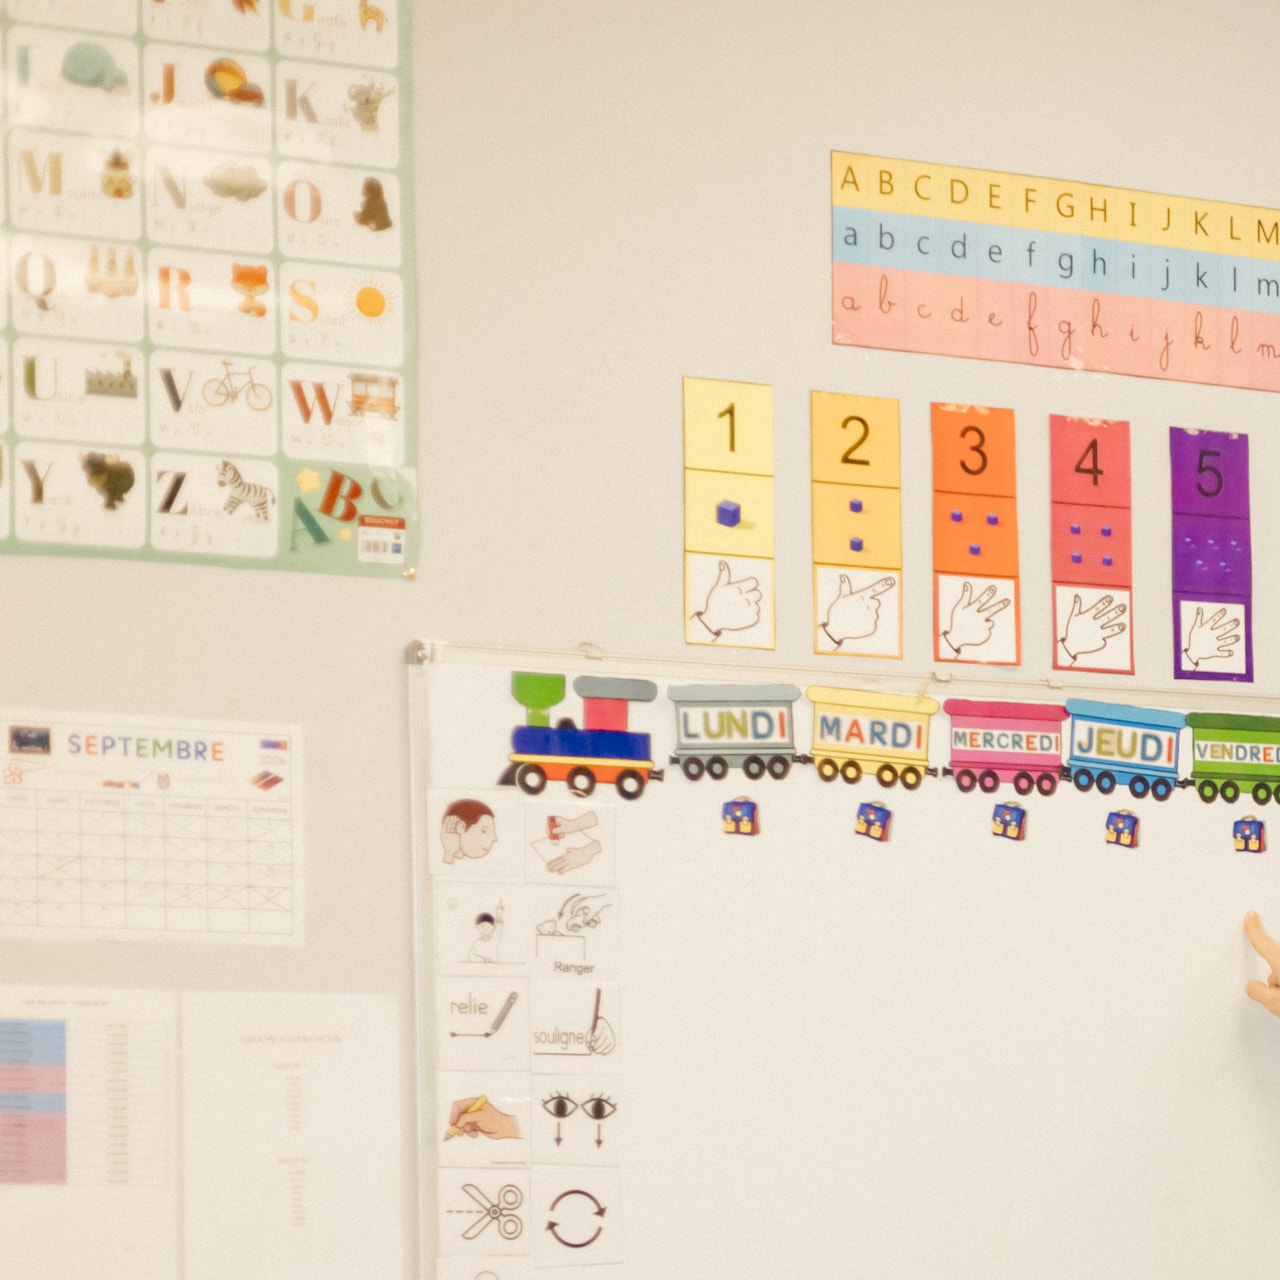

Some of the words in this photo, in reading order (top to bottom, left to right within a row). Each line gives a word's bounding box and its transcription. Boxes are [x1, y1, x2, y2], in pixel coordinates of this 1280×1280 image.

[151, 63, 175, 105] J
[285, 78, 320, 123] K
[283, 179, 322, 223] O
[841, 166, 859, 191] A
[880, 170, 893, 195] B
[914, 175, 931, 200] C
[951, 179, 968, 204] D
[989, 184, 1001, 209] E
[1025, 188, 1036, 212] F
[1057, 193, 1074, 218] G
[1090, 197, 1107, 222] H
[1130, 202, 1136, 226] I
[1162, 208, 1170, 231] J
[1195, 211, 1208, 236] K
[1230, 216, 1241, 240] L
[1258, 220, 1278, 245] M
[844, 227, 857, 246] a
[880, 223, 894, 250] b
[917, 236, 929, 254] c
[951, 233, 966, 258] d
[989, 245, 1002, 263] e
[1027, 241, 1035, 266] f
[1059, 253, 1073, 278] g
[1093, 249, 1106, 275] h
[1162, 259, 1169, 291] j
[1197, 262, 1207, 288] k
[1258, 279, 1279, 297] m
[288, 278, 319, 322] S
[158, 368, 195, 413] V
[288, 379, 344, 426] W
[718, 403, 735, 452] 1
[841, 416, 869, 465] 2
[960, 426, 987, 475] 3
[1075, 439, 1103, 486] 4
[1196, 449, 1223, 498] 5
[21, 459, 54, 504] Y
[157, 470, 188, 515] Z
[67, 734, 224, 762] SEPTEMBRE
[683, 707, 785, 739] LUNDI
[819, 716, 923, 750] MARDI
[954, 730, 1059, 752] MERCREDI
[1077, 726, 1174, 763] JEUDI
[554, 962, 595, 975] Ranger
[450, 992, 488, 1014] relie
[533, 1027, 584, 1049] souligne
